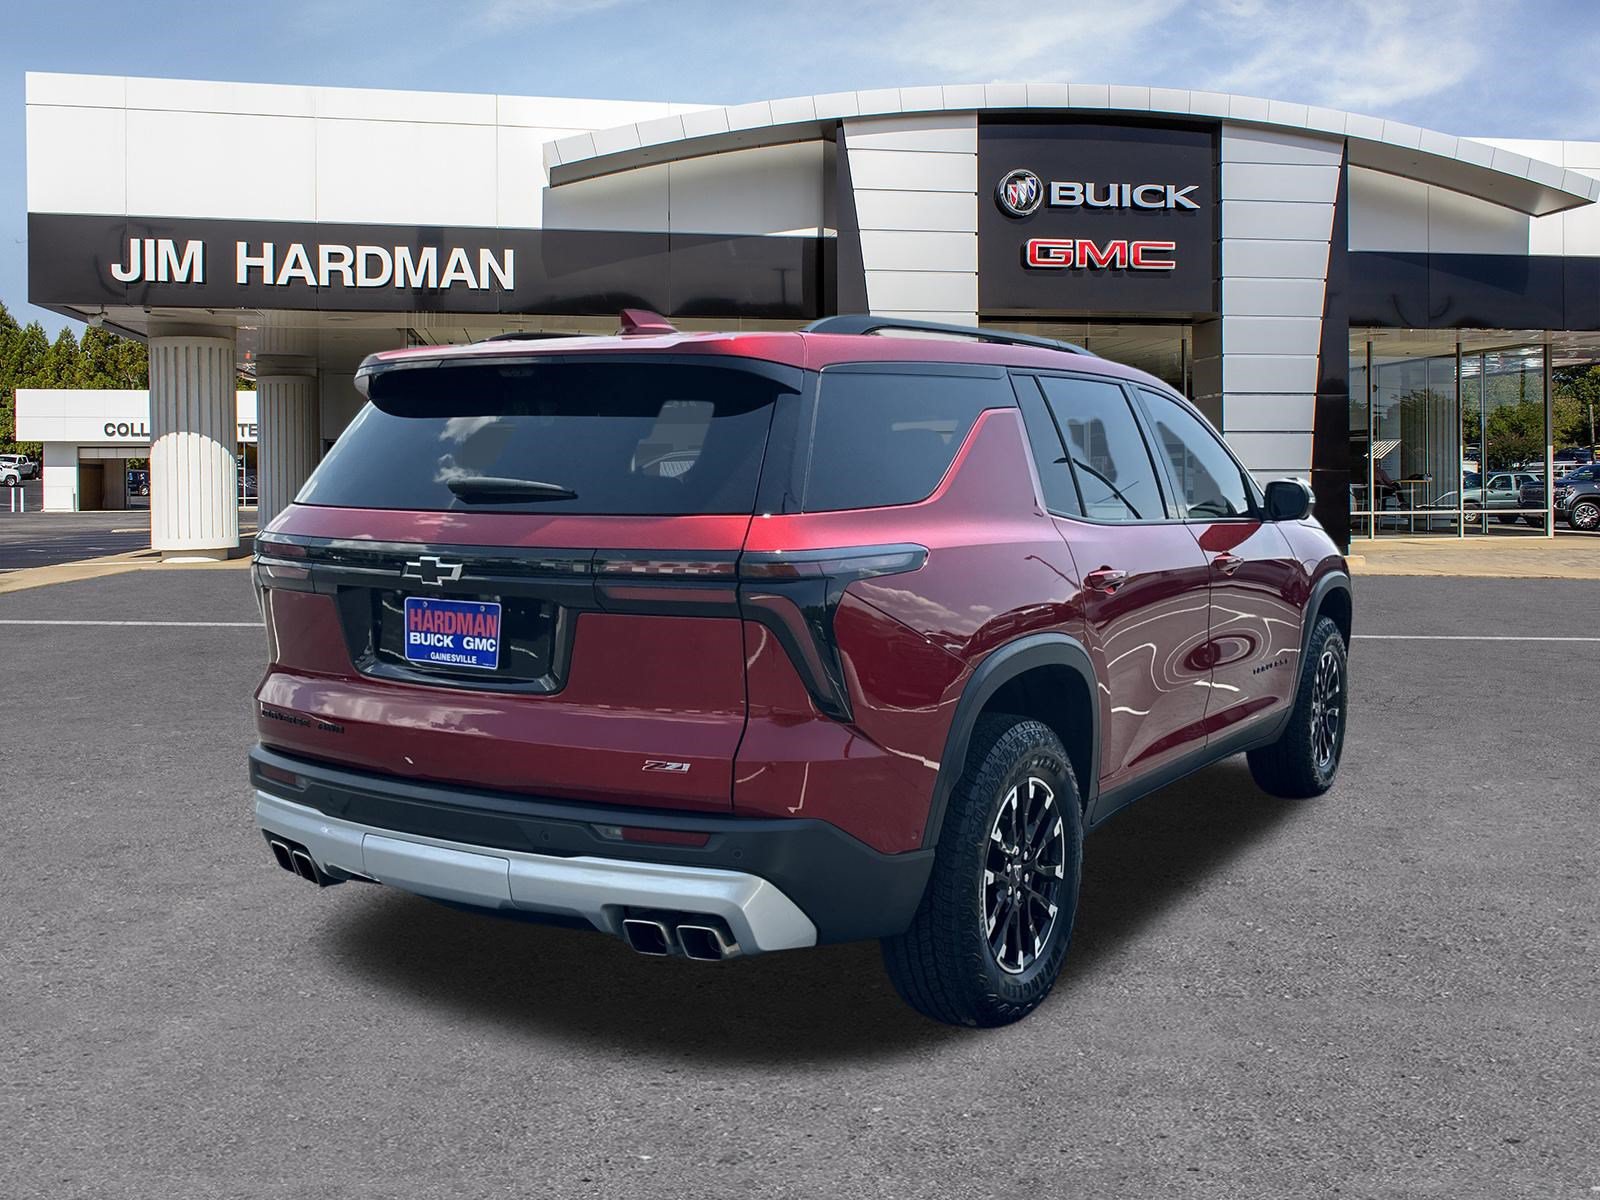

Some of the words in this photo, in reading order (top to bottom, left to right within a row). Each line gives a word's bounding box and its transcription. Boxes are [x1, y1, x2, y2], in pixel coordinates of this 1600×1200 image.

[1050, 181, 1200, 210] BUICK
[111, 238, 205, 284] JIM
[236, 241, 515, 291] HARDMAN
[1025, 238, 1177, 271] GMC
[409, 607, 498, 638] HARDMAN
[409, 631, 454, 648] BUICK
[462, 636, 497, 652] GMC
[430, 651, 477, 664] GAINESVILLE
